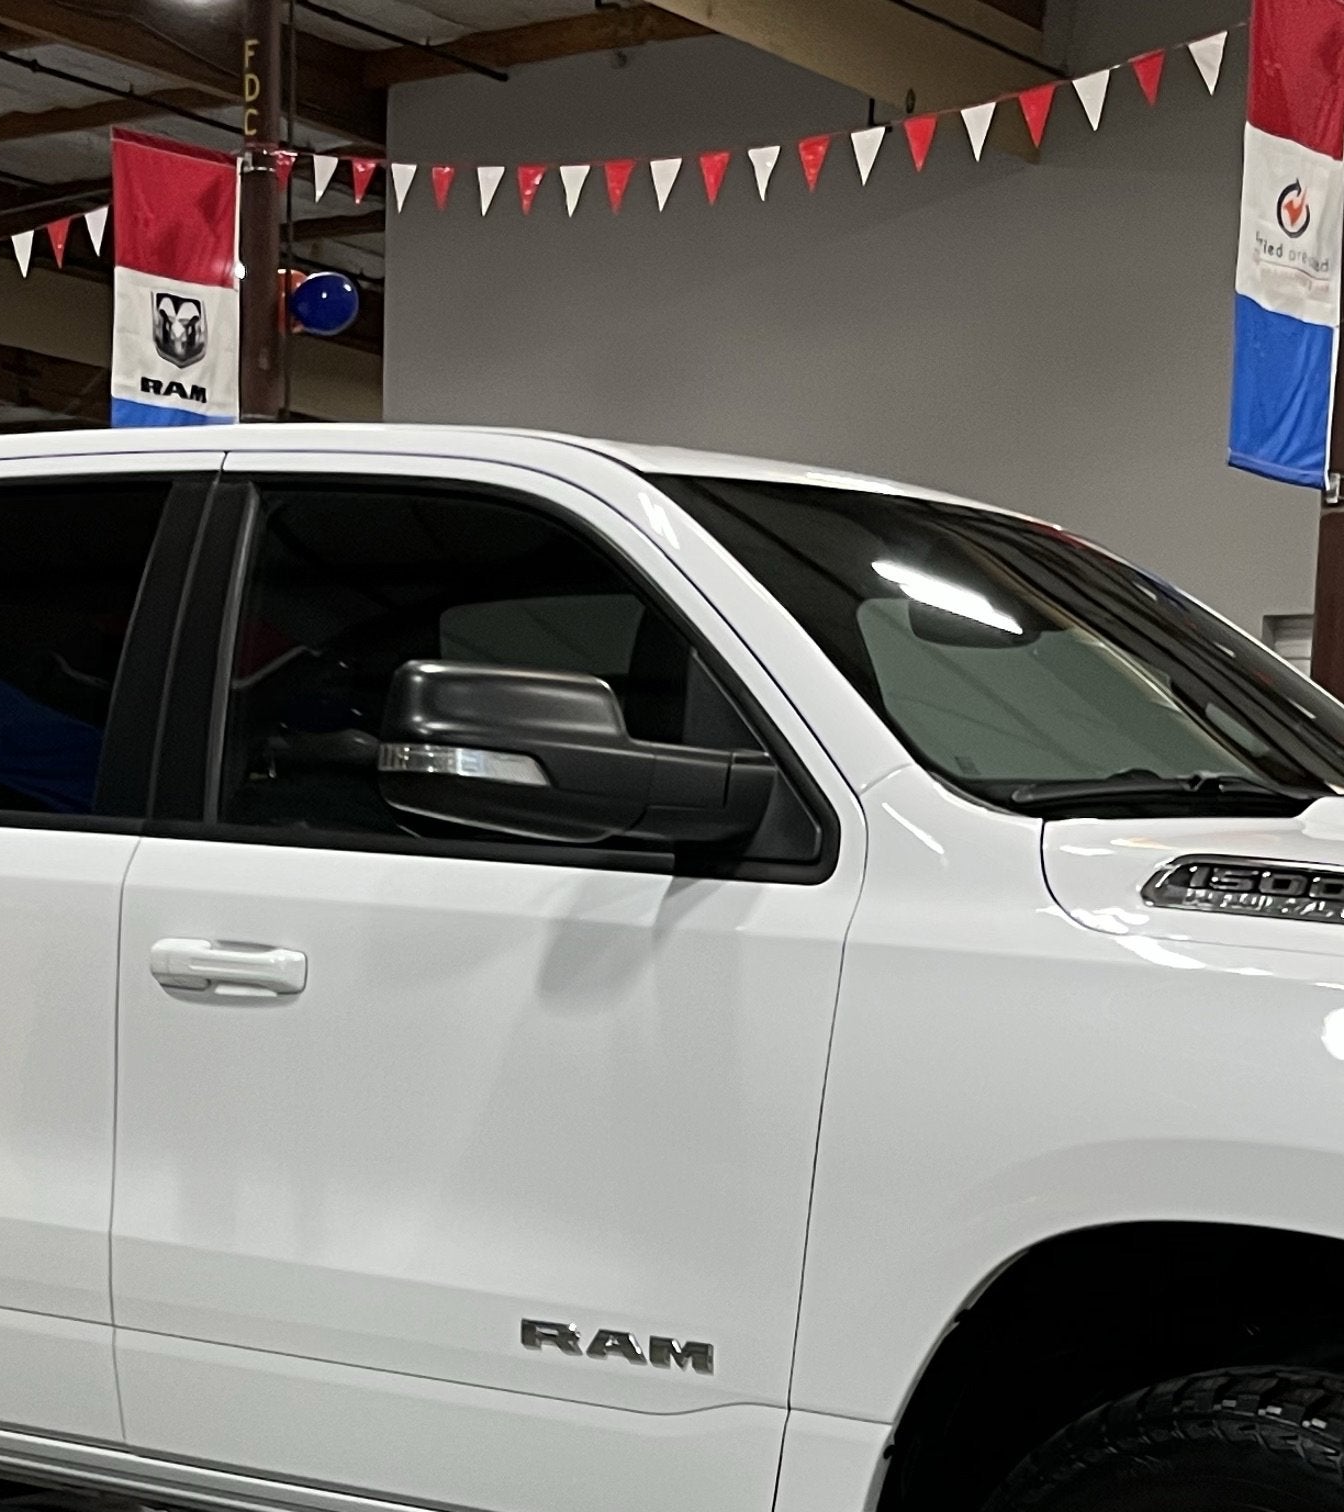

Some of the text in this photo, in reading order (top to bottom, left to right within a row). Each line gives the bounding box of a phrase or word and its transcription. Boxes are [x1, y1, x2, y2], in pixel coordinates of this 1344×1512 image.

[245, 39, 261, 135] FDC
[140, 376, 207, 403] RAM
[521, 1318, 714, 1376] RAM
